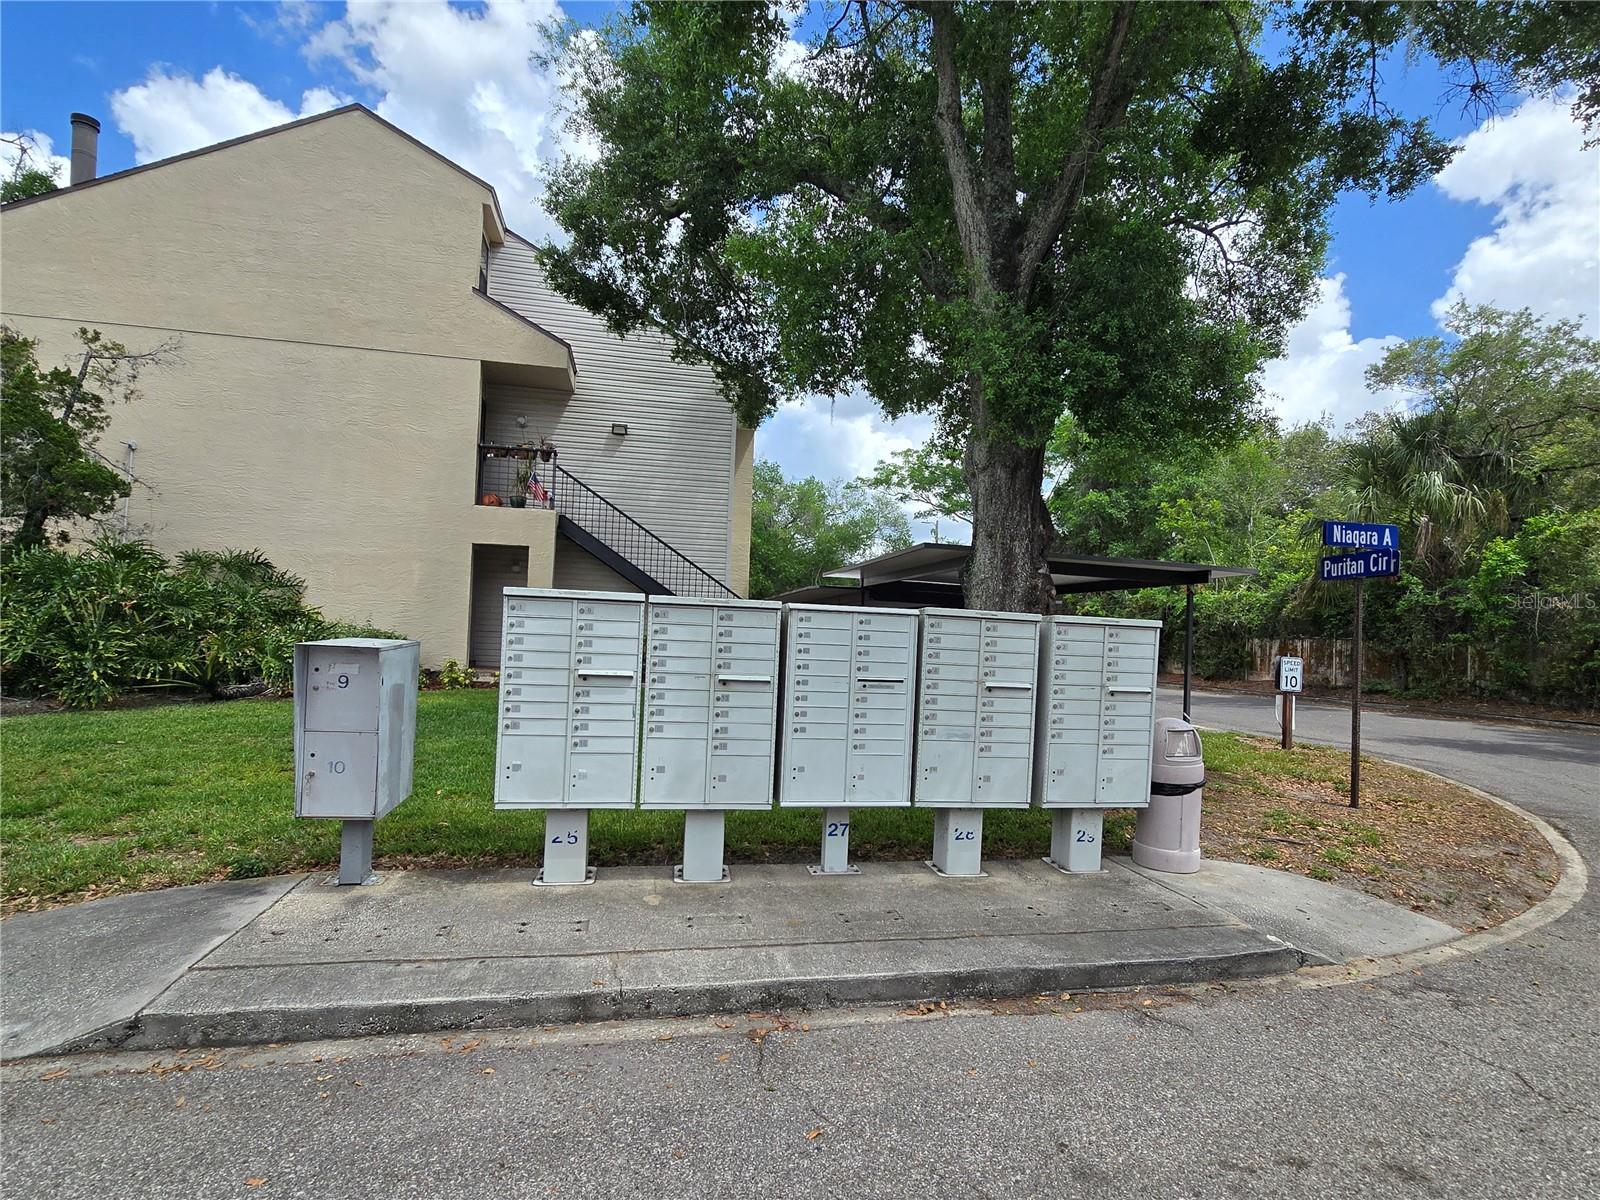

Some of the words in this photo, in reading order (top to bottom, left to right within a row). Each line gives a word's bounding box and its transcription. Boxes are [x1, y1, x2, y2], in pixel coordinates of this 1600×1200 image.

[1333, 524, 1378, 548] Niagara
[1382, 528, 1392, 546] A
[1323, 557, 1364, 578] Puritan
[1369, 553, 1388, 572] Cir
[337, 674, 349, 689] 9
[1285, 675, 1298, 688] 10
[327, 761, 346, 774] 10
[827, 822, 849, 837] 27
